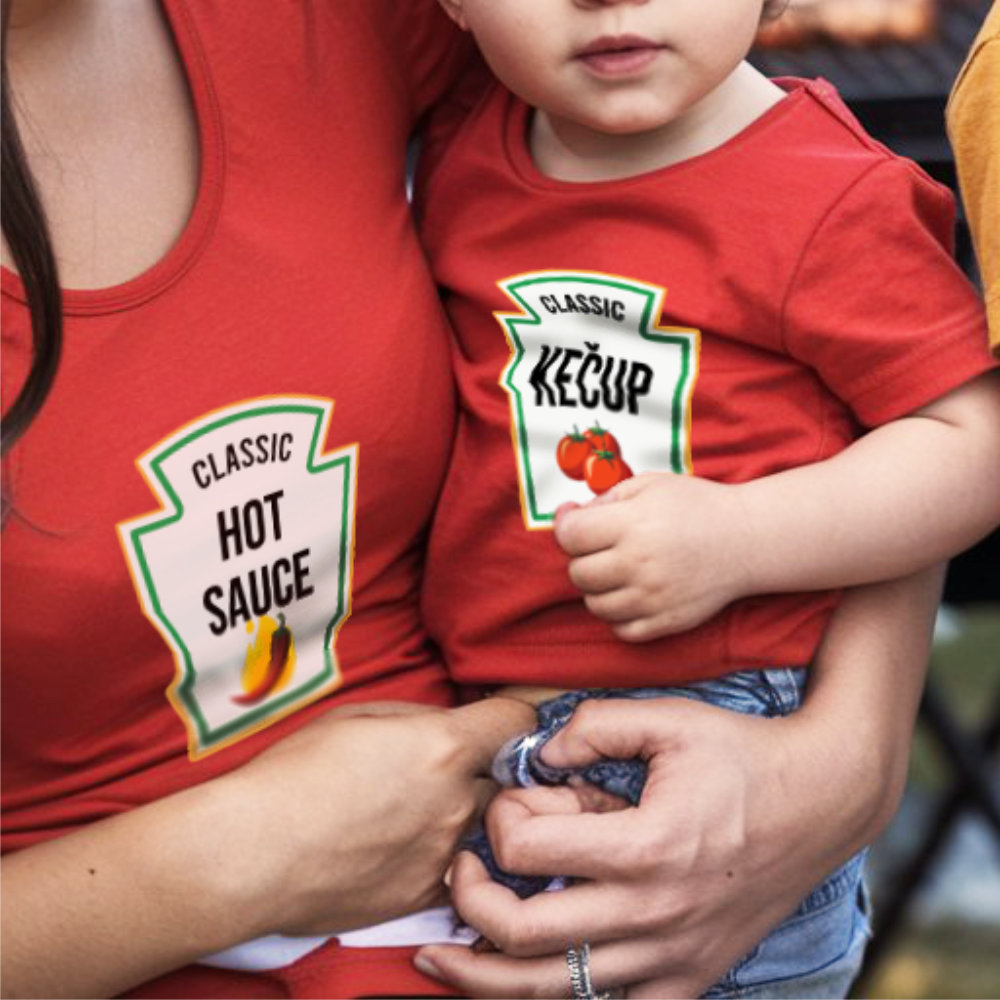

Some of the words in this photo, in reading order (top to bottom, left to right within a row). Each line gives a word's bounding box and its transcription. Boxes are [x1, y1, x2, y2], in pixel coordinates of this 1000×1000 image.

[539, 294, 625, 322] CLASSIC
[529, 341, 654, 415] KEČUP
[191, 432, 293, 489] CLASSIC
[216, 489, 285, 561] HOT
[202, 548, 315, 637] SAUCE
